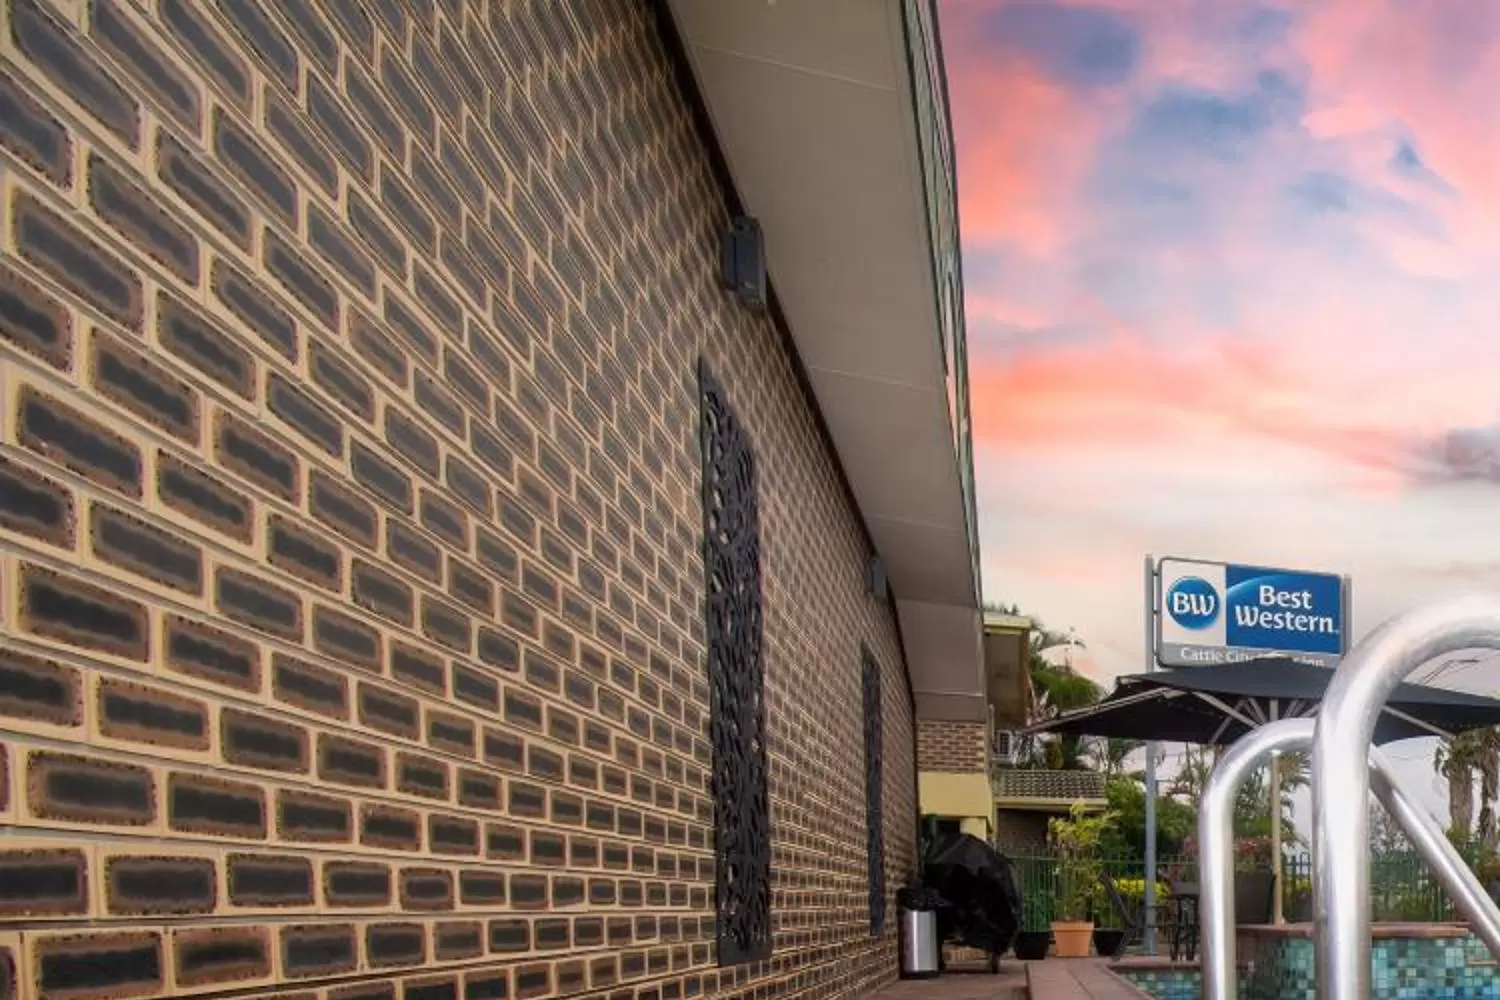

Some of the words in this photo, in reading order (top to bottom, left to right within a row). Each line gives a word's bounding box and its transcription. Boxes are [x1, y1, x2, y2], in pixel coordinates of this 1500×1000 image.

[1173, 592, 1214, 616] BW
[1259, 585, 1312, 609] Best
[1235, 605, 1334, 633] Western
